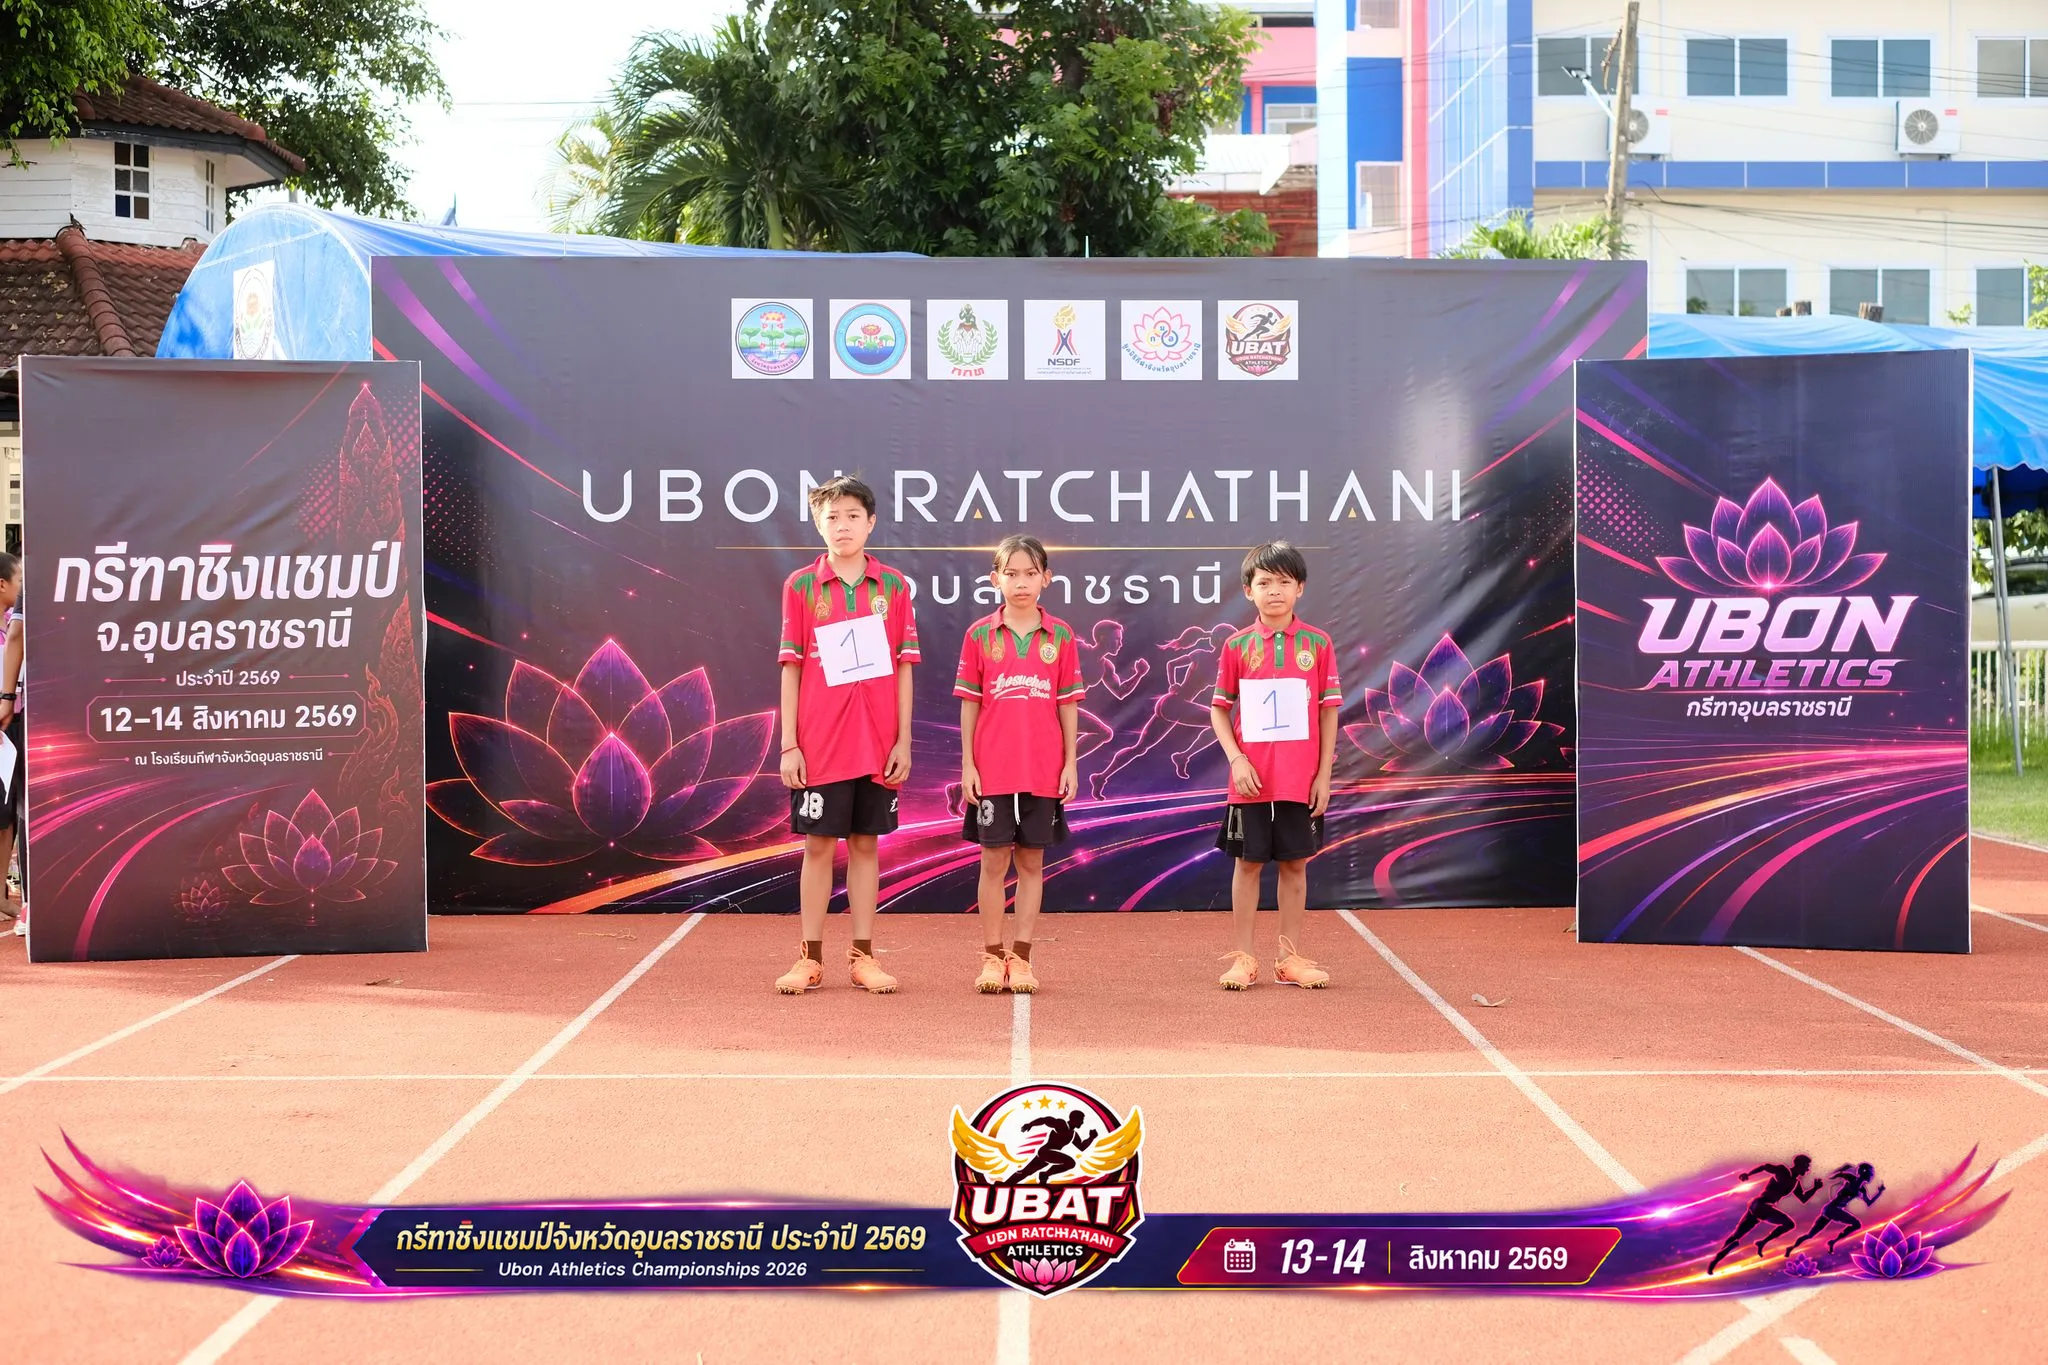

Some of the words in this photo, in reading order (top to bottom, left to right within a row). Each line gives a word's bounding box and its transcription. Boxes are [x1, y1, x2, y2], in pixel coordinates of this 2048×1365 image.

[1047, 358, 1081, 366] NSDF
[1231, 341, 1286, 355] UBAT
[895, 469, 1461, 523] RATCHATHANI
[54, 541, 402, 603] กรีฑาชิงแชมป์
[902, 562, 1221, 619] บลาชธานี
[97, 606, 353, 664] จ.อุบลราชธานี
[1638, 596, 1918, 653] UBON
[840, 628, 875, 674] 1
[176, 669, 233, 686] ประจำปี
[239, 670, 281, 686] 2569
[1646, 659, 1903, 688] ATHLETICS
[192, 705, 286, 730] สิงหาคม
[295, 704, 357, 728] 2569
[1262, 690, 1290, 731] 1
[1686, 695, 1853, 723] กรีฑาอุบลราชธานี
[134, 755, 147, 766] ณ
[150, 747, 323, 766] โรงเรียนกีฬาจังหวัดอุบลราชธานี
[799, 790, 825, 820] 18
